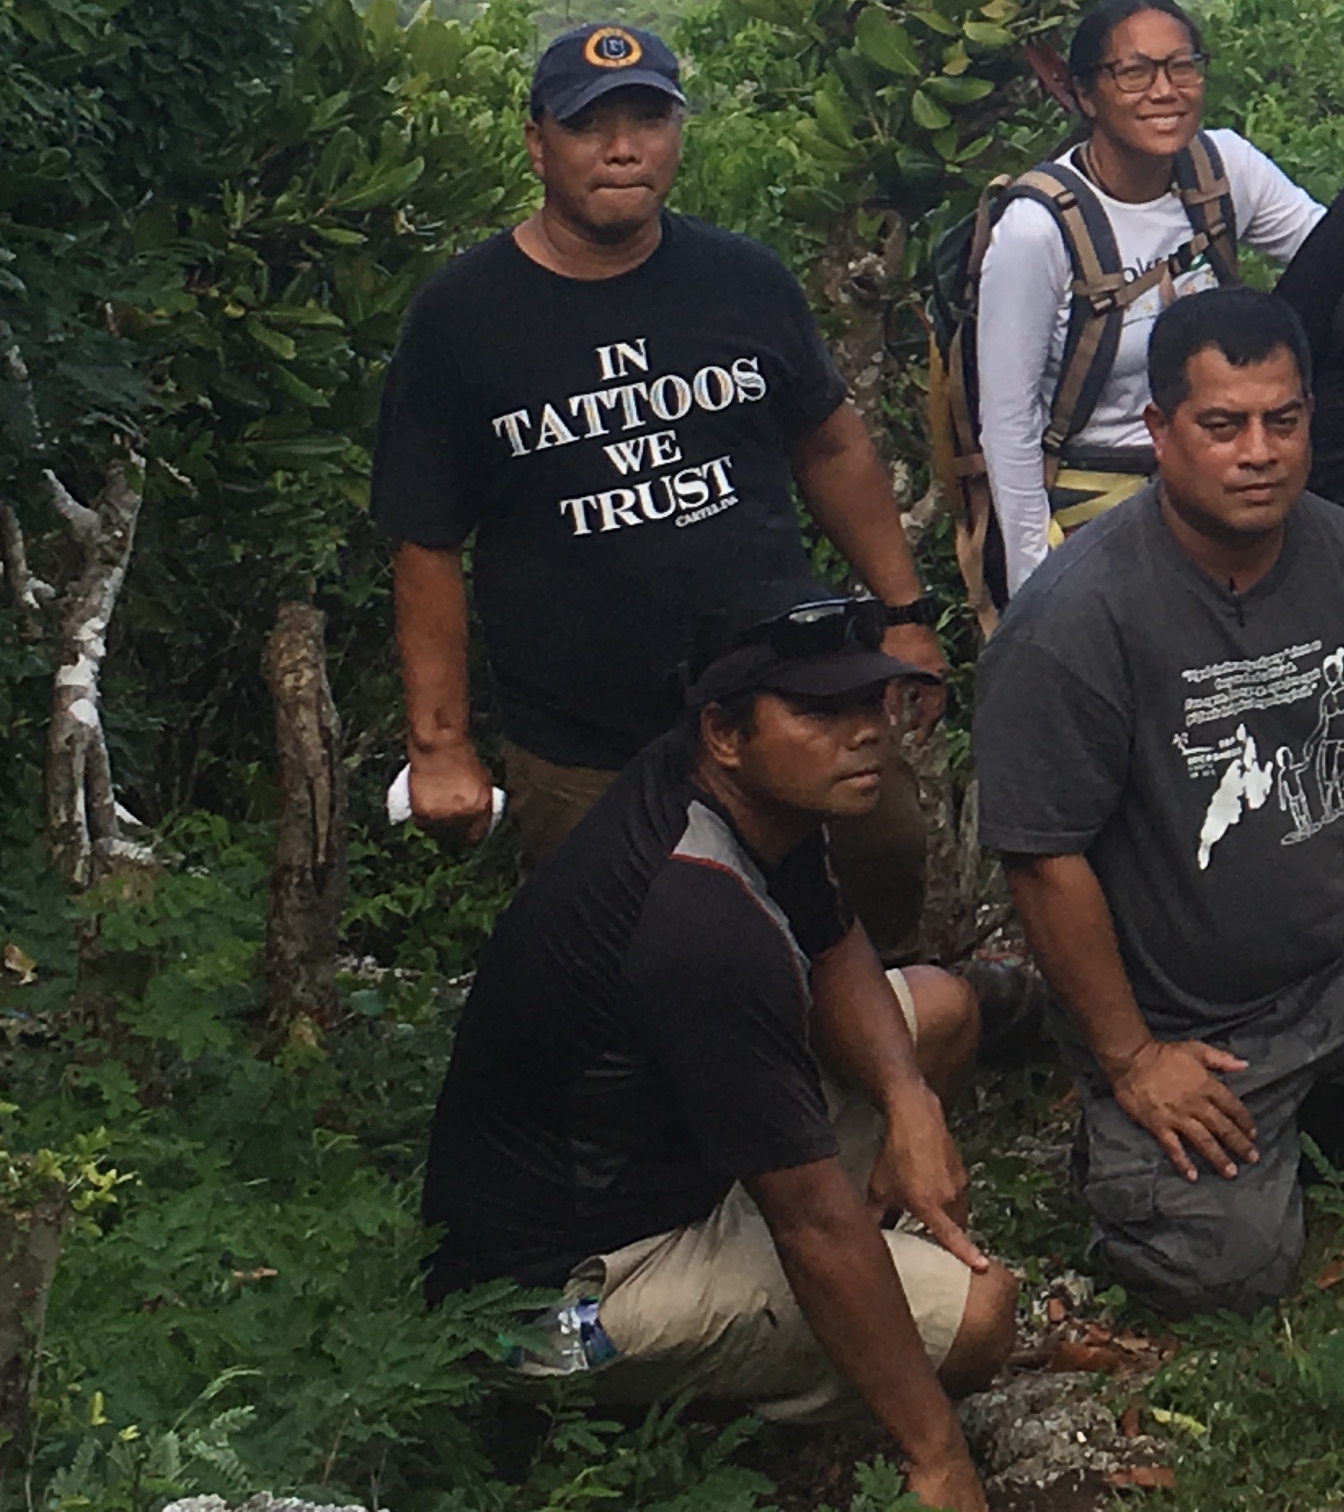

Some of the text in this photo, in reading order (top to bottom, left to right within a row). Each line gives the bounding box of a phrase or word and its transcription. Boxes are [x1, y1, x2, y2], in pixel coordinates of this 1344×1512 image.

[595, 338, 650, 381] IN
[491, 356, 767, 458] TATTOOS
[603, 429, 683, 476] WE
[560, 455, 736, 537] TRUST
